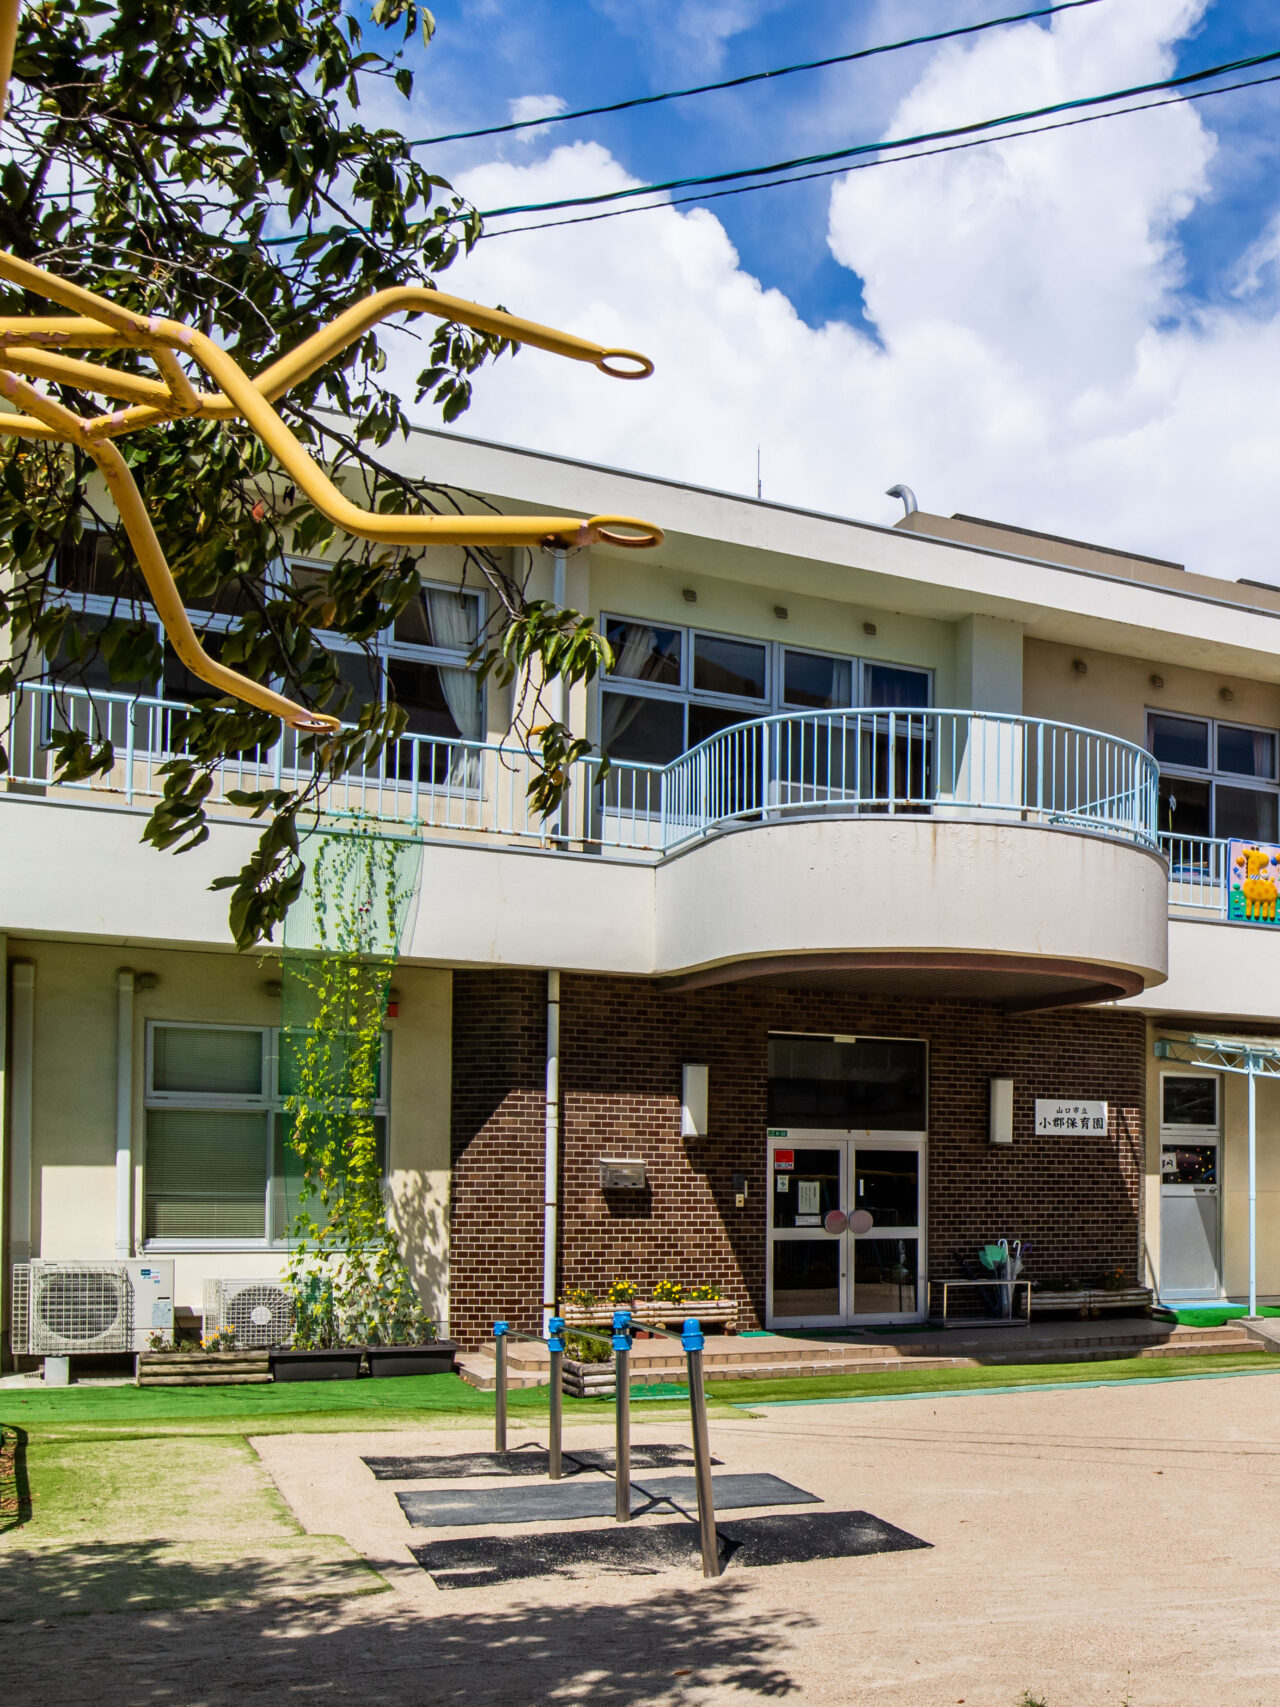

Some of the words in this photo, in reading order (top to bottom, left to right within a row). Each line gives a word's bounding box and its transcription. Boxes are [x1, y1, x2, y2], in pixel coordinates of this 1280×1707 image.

[1056, 1106, 1088, 1115] 山口市立
[1039, 1116, 1104, 1130] 小郡保育園
